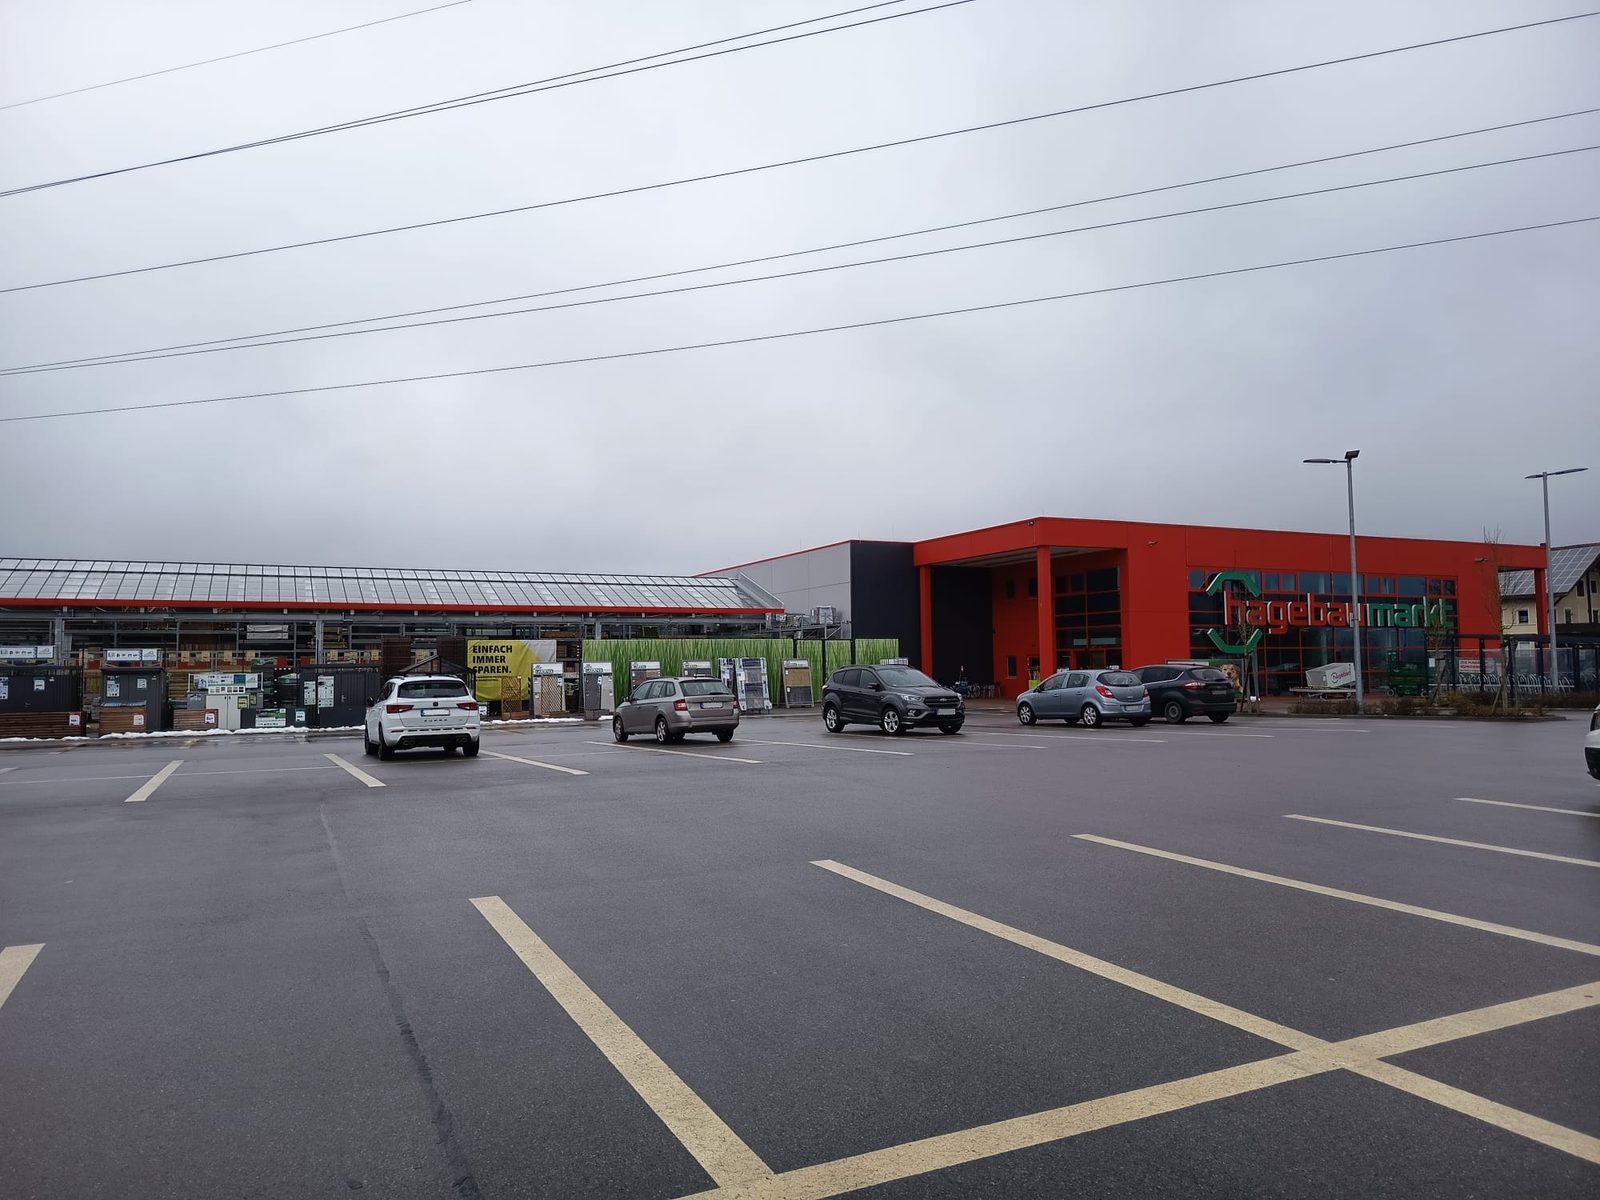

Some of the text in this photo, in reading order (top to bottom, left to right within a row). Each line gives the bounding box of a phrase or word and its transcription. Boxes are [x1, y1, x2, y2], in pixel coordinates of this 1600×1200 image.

[1223, 590, 1455, 635] hagebaumarkt
[472, 645, 513, 654] EINFACH
[472, 655, 506, 664] IMMER
[472, 665, 512, 674] SPAREN.
